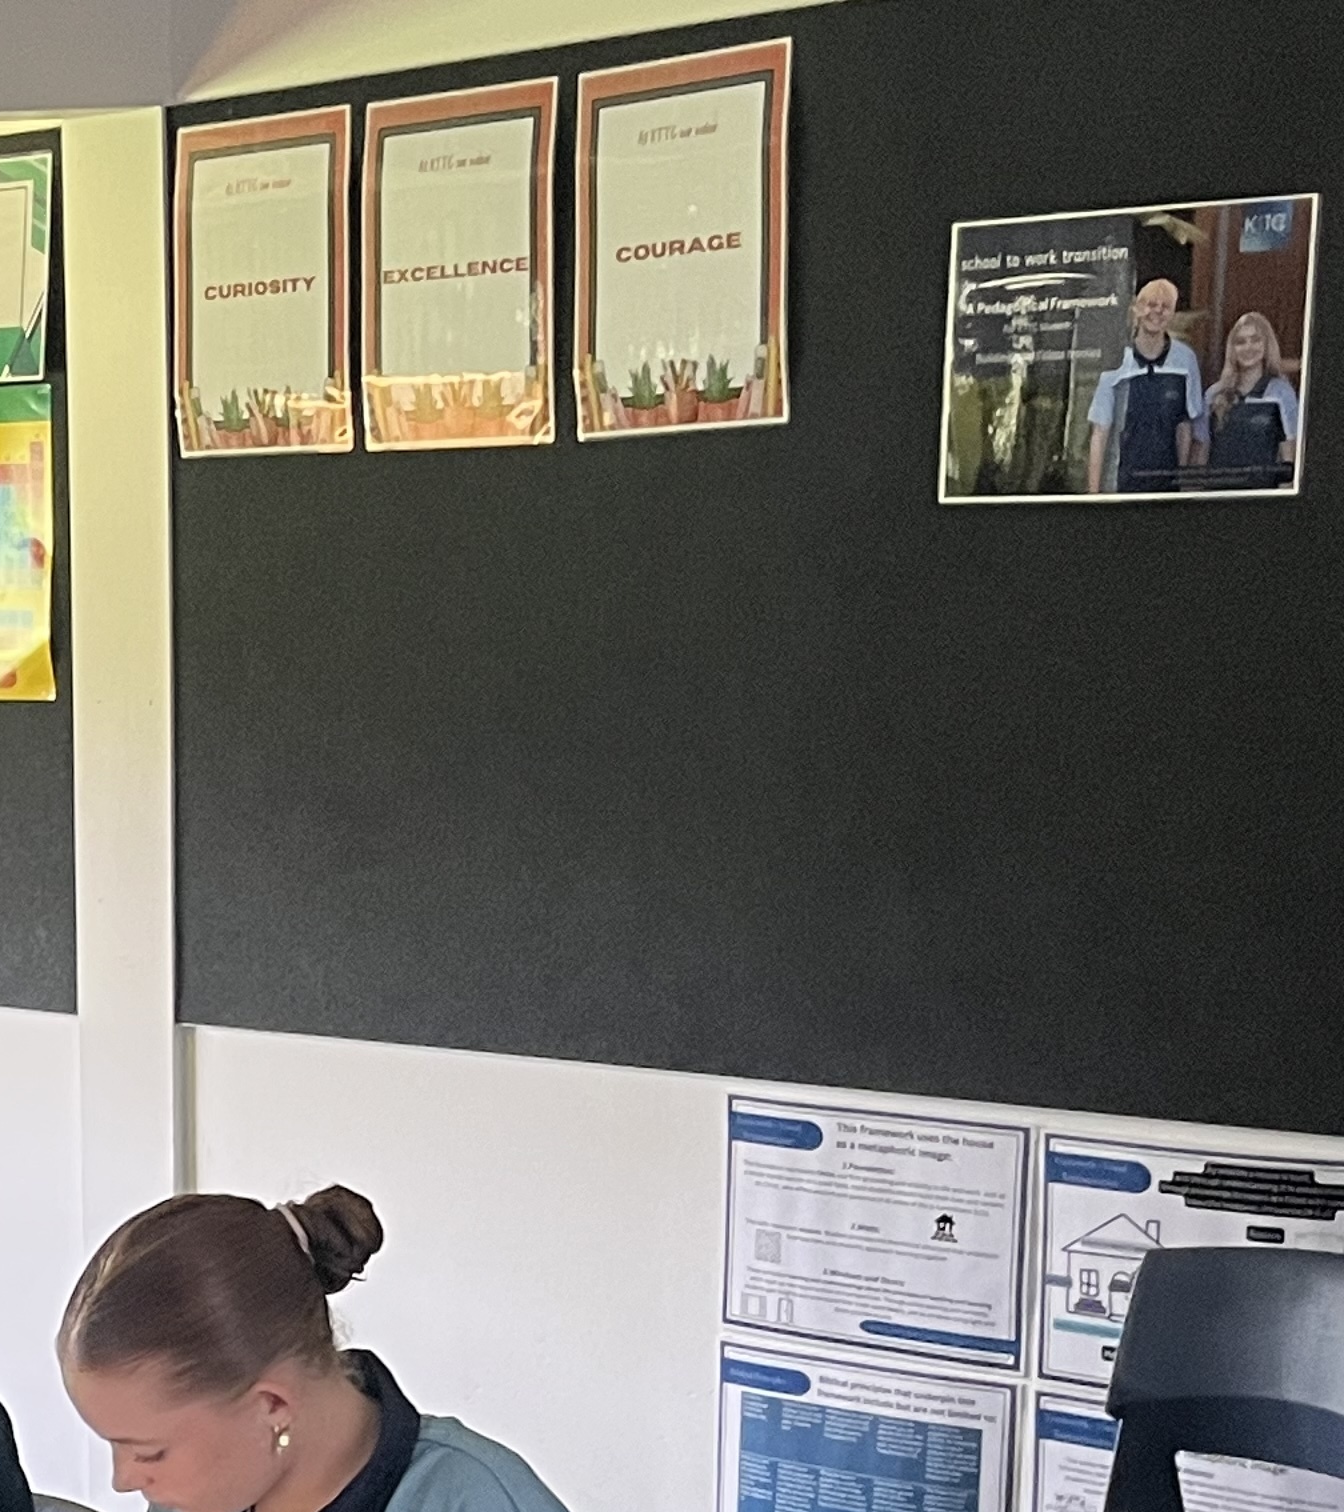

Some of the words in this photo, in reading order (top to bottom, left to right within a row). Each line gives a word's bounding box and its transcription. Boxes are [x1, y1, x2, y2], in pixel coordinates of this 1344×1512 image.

[615, 231, 742, 263] COURAGE
[961, 252, 1001, 271] school
[1006, 255, 1020, 268] to
[1025, 249, 1057, 267] work
[1063, 246, 1129, 264] transition
[382, 256, 529, 285] EXCELLENCE
[204, 275, 316, 301] CURIOSITY
